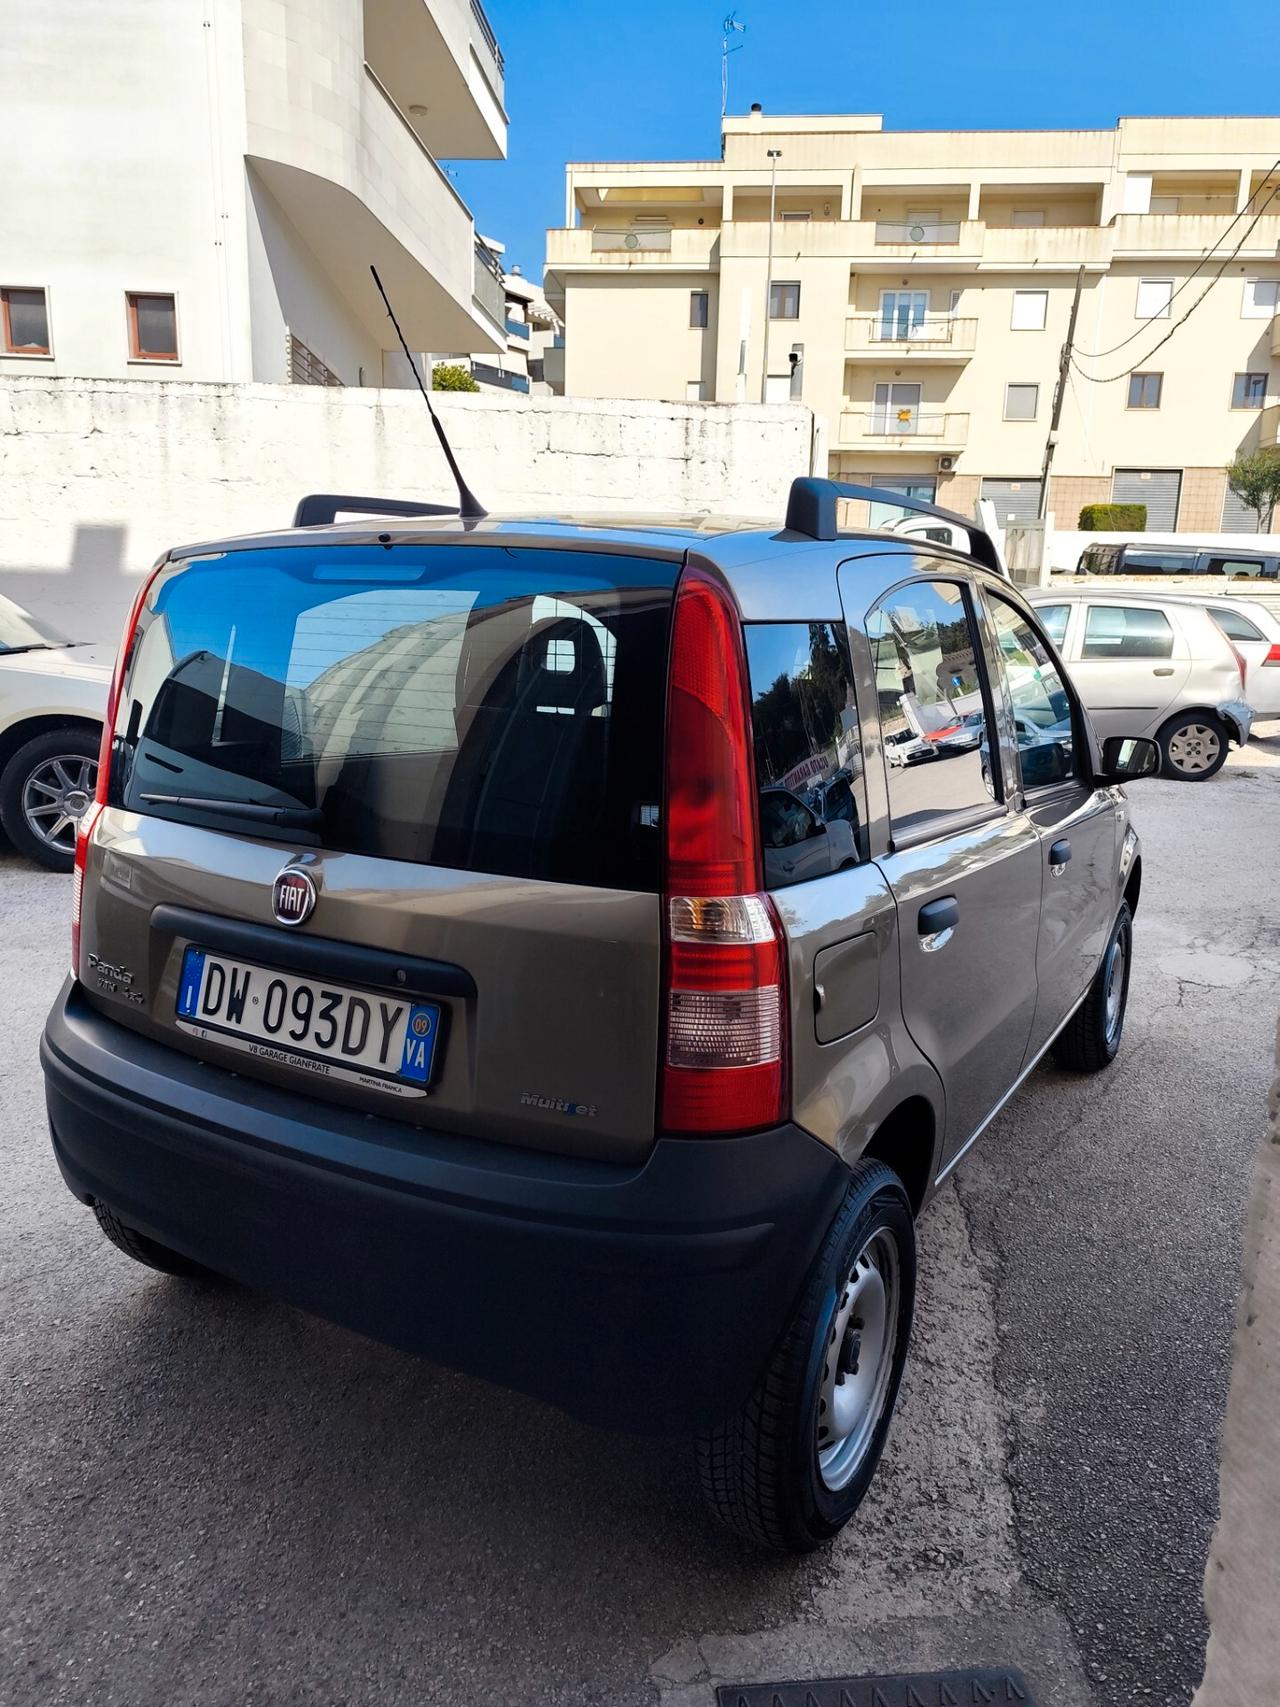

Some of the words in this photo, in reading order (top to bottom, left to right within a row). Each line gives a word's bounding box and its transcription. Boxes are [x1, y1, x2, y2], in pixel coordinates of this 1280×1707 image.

[279, 884, 305, 912] FIAT
[88, 953, 133, 985] Panda
[202, 961, 252, 1025] DW
[262, 979, 404, 1064] 093DY
[414, 1017, 428, 1033] 09
[248, 1044, 258, 1054] V8
[259, 1047, 288, 1063] GARAGE
[288, 1054, 331, 1075] GIANFRATE
[406, 1037, 425, 1069] VA
